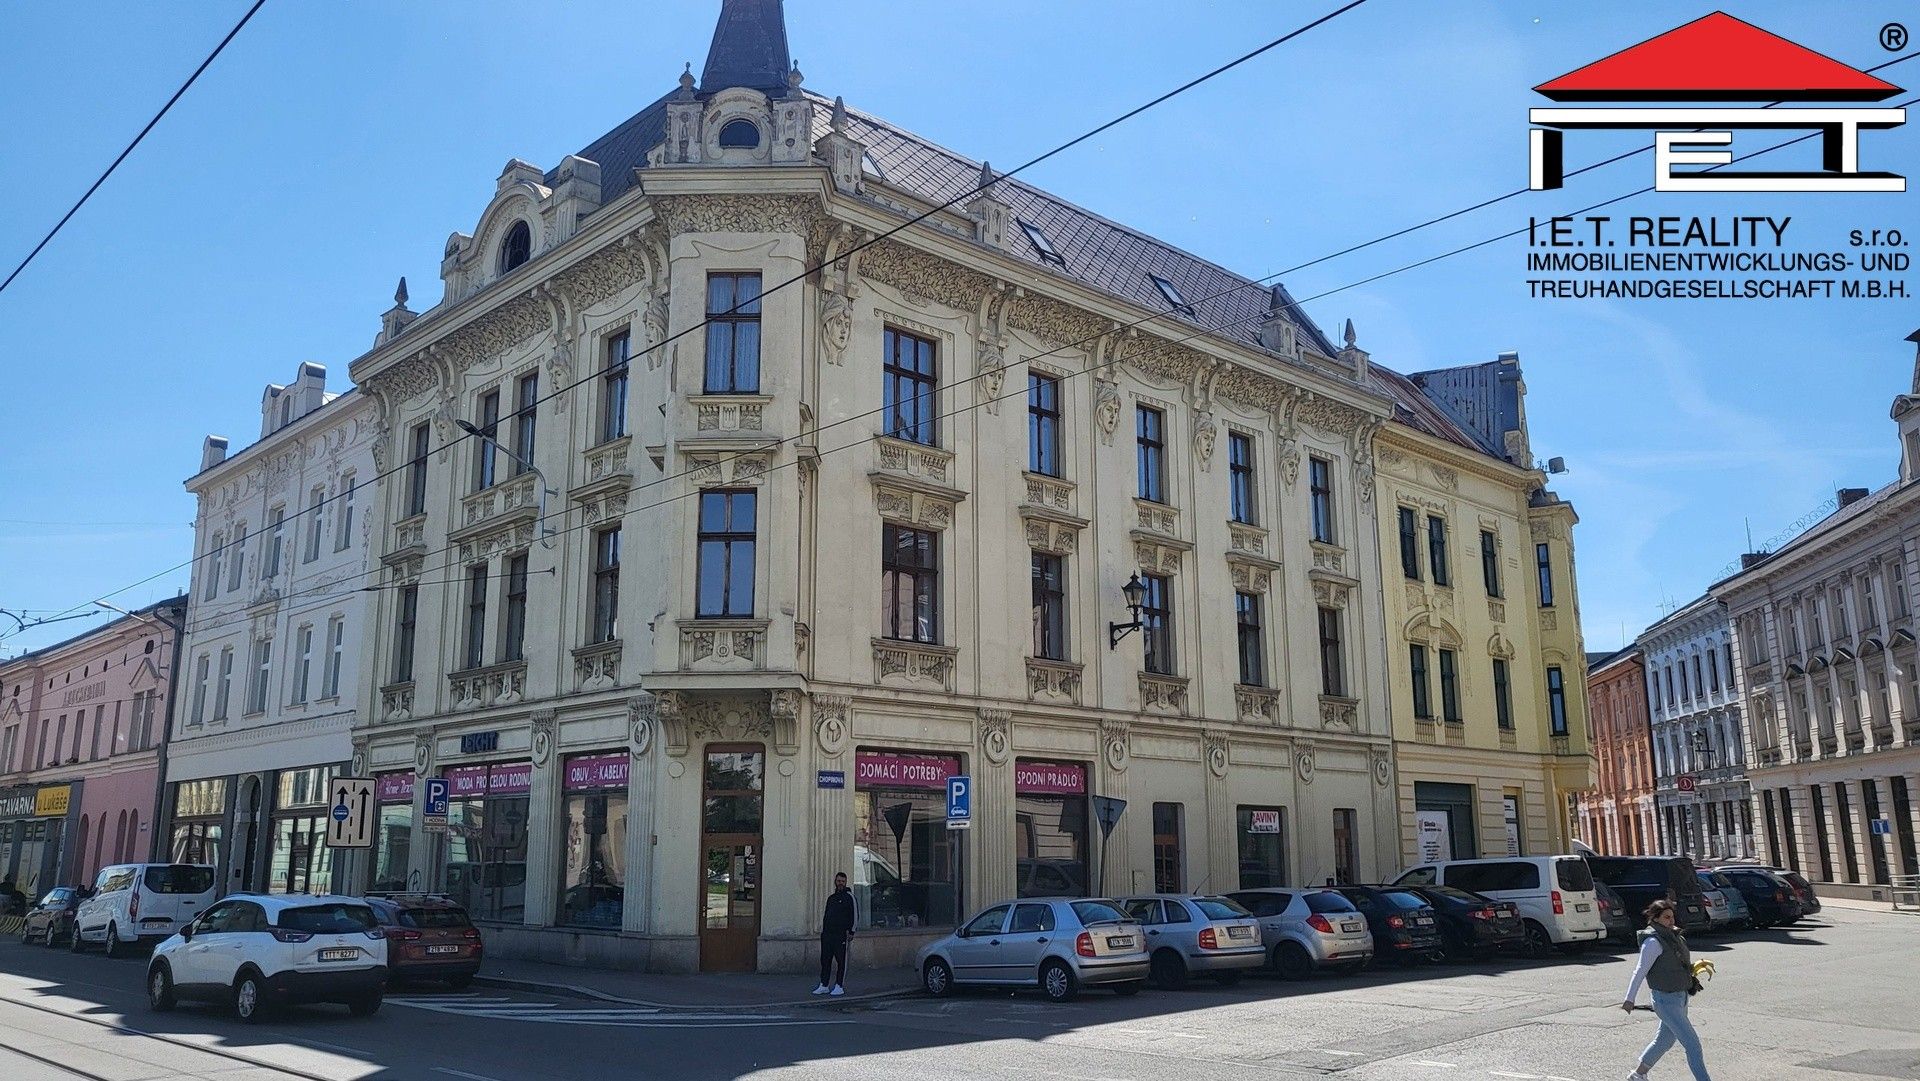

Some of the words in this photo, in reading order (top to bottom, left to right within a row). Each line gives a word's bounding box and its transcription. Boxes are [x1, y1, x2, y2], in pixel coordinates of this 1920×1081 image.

[571, 766, 590, 782] OBUV
[599, 763, 629, 780] KABELKY
[860, 760, 898, 779] DOMÁCÍ
[903, 762, 941, 780] POTŘEBY
[1017, 769, 1046, 785] SPODNÍ
[1047, 769, 1078, 787] PRÁDLO
[476, 775, 488, 788] PRO
[489, 773, 508, 788] CELOU
[430, 783, 444, 804] P
[952, 781, 966, 806] P
